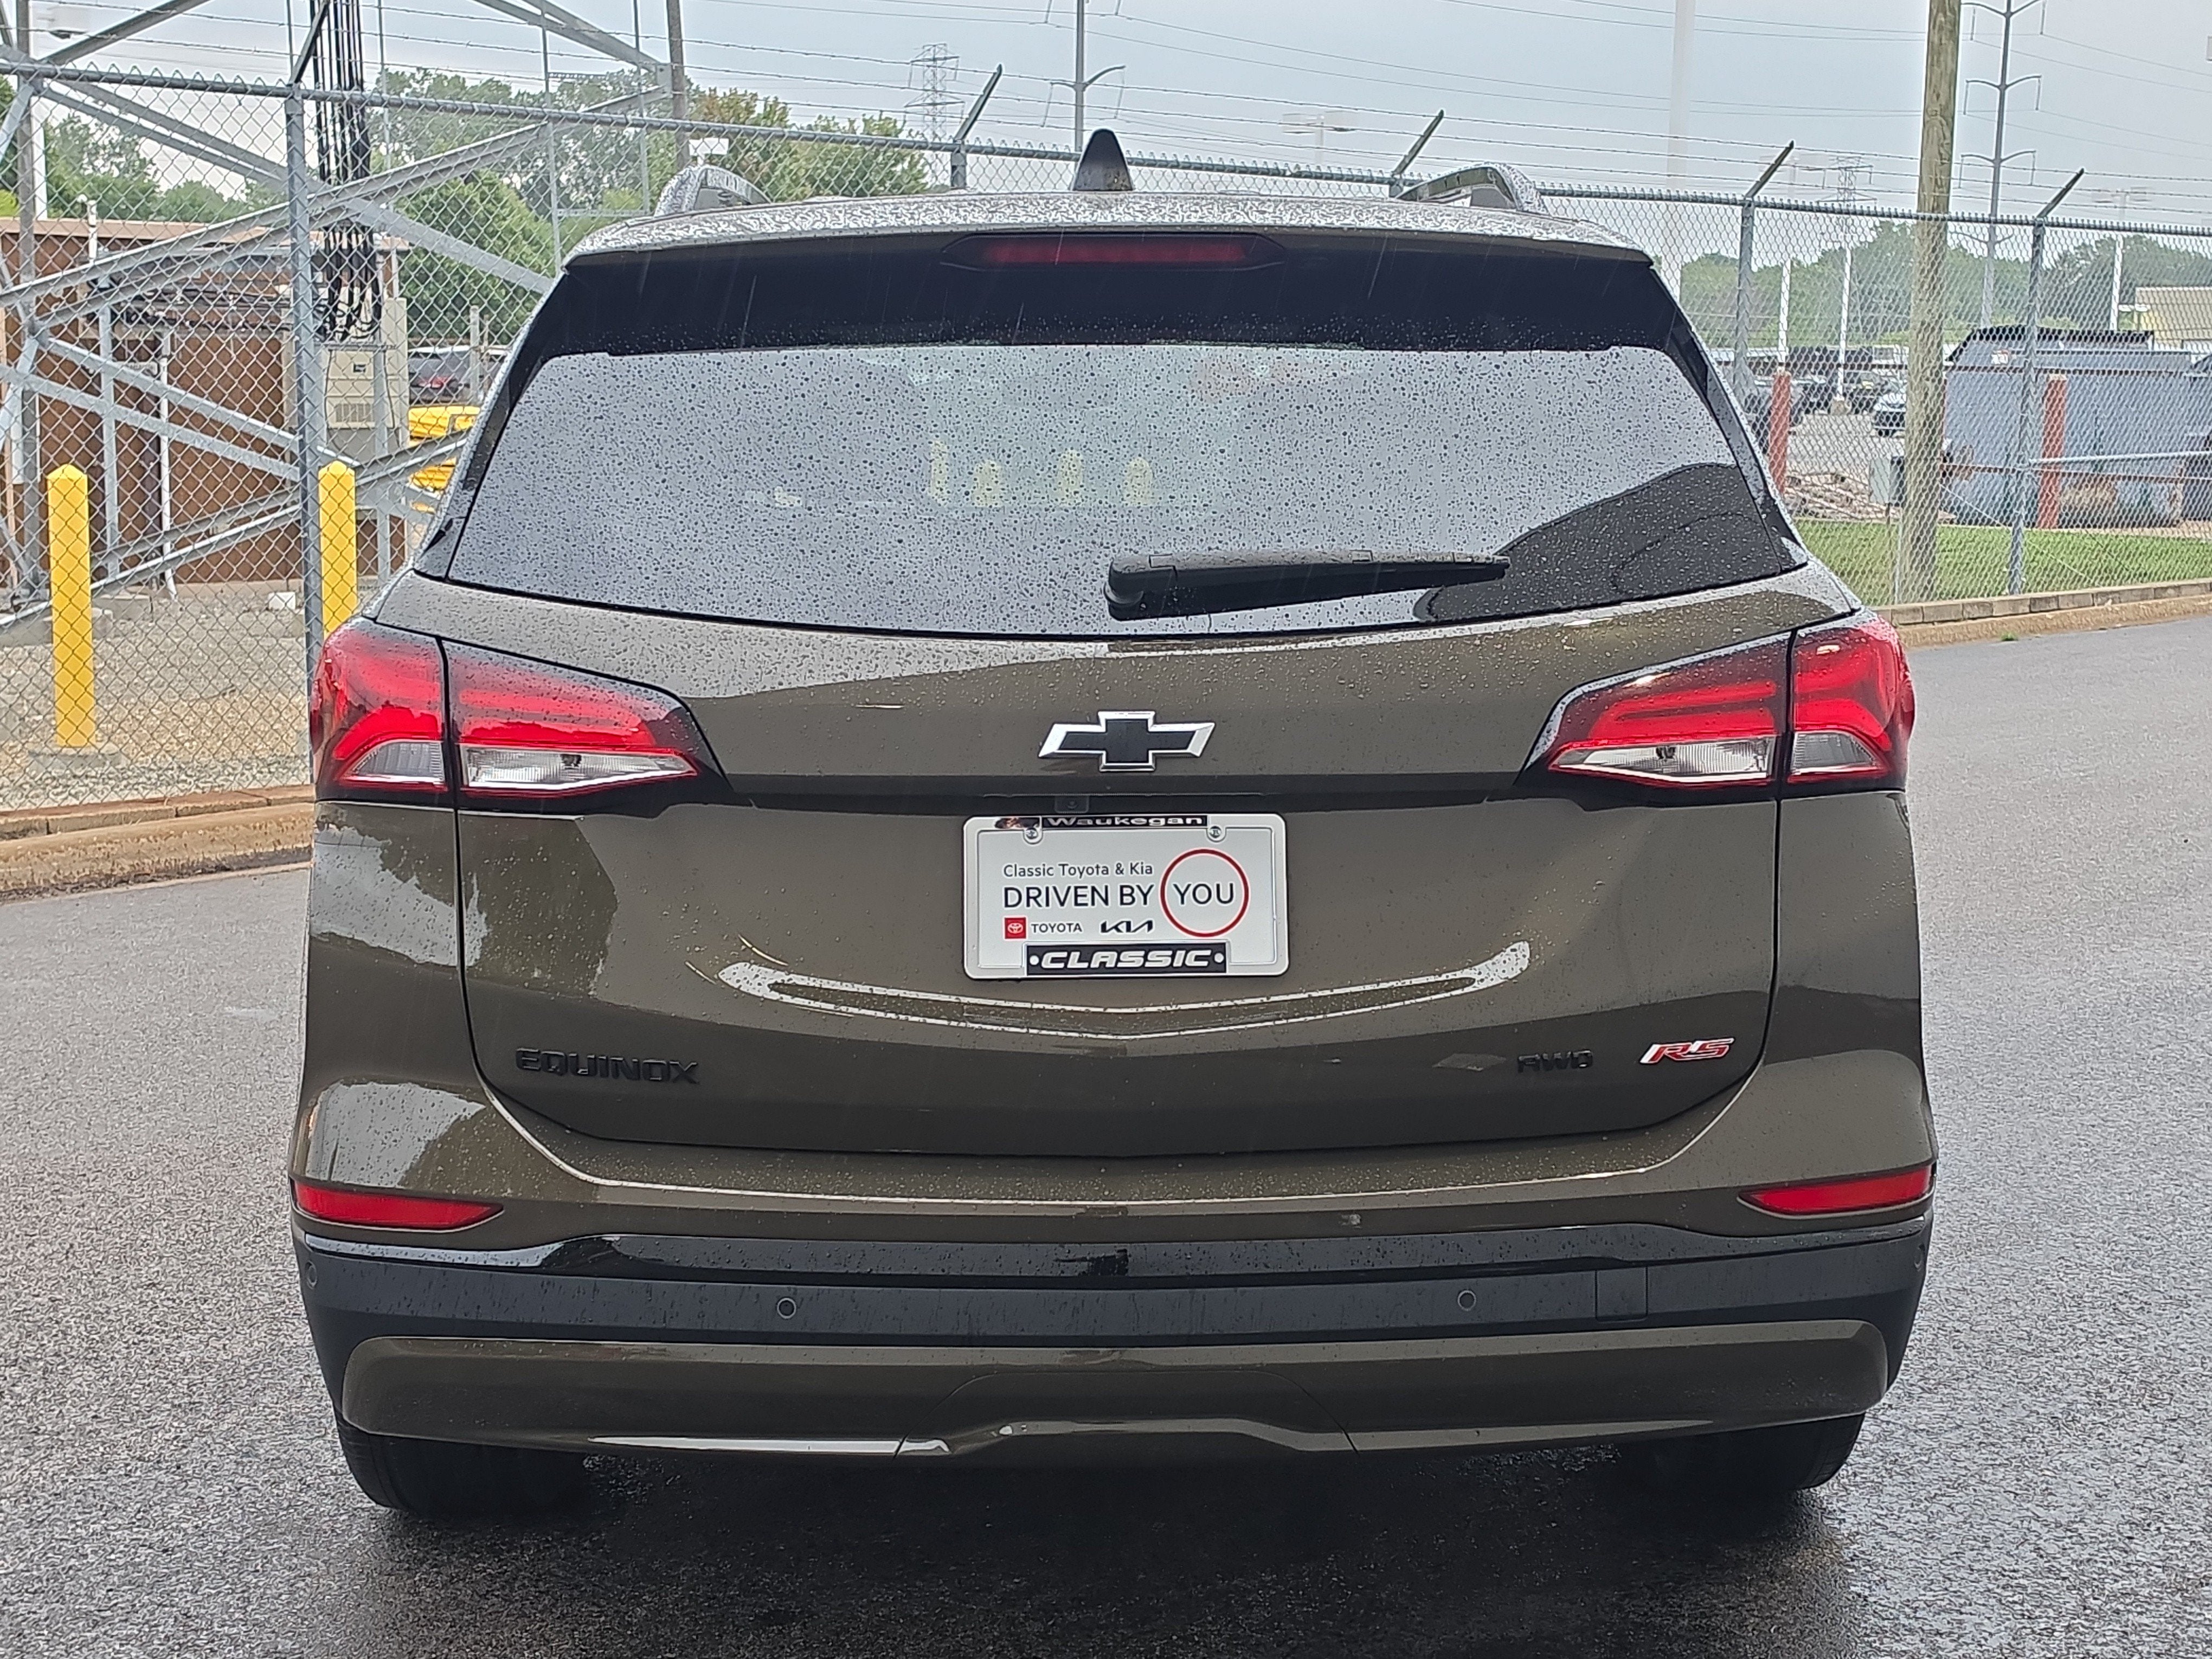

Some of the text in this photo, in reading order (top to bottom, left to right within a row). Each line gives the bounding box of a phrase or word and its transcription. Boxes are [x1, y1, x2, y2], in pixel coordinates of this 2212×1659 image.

[1047, 816, 1203, 826] Waukegan
[1004, 862, 1153, 879] Classic Toyota & Kia
[1004, 884, 1234, 908] DRIVEN BY YOU
[1032, 923, 1082, 933] TOYOTA
[1041, 950, 1211, 968] CLASSIC
[1519, 1050, 1592, 1072] AWD
[1639, 1038, 1734, 1064] RS
[516, 1047, 700, 1084] EQUINOX
